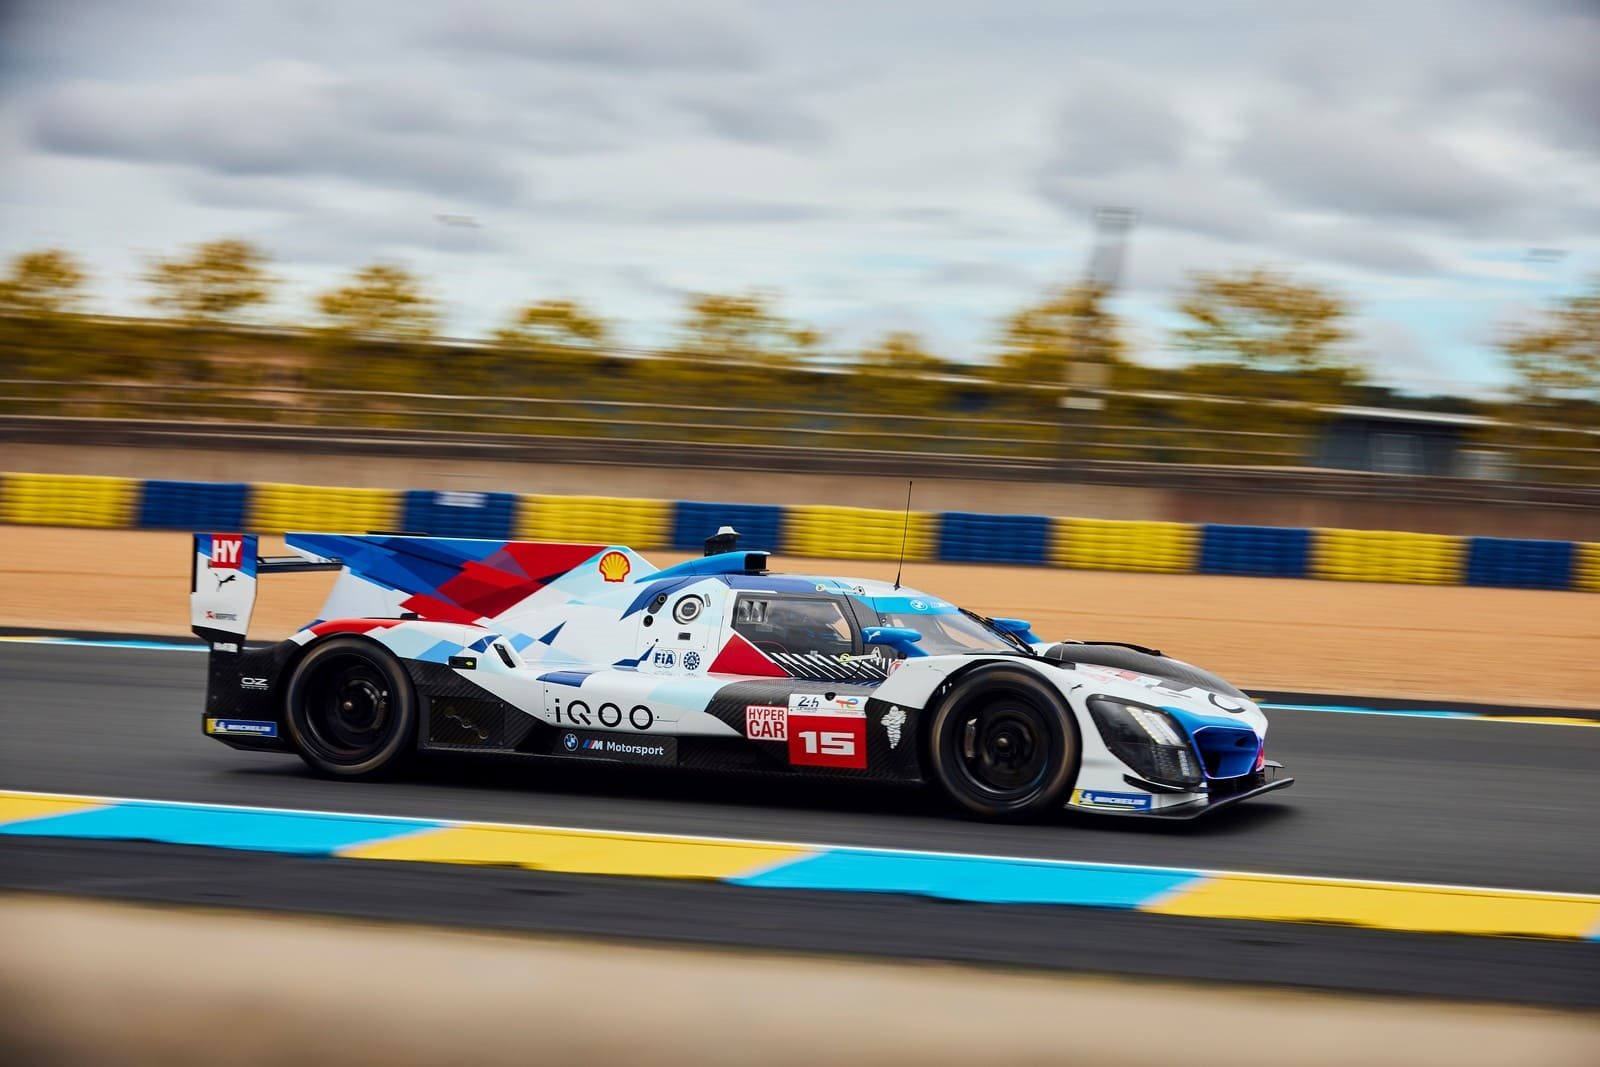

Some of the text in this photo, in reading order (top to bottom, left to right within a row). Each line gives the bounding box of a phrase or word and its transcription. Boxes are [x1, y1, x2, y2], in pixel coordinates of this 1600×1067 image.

[212, 539, 242, 563] HY
[555, 698, 653, 730] iQOO
[748, 709, 785, 721] HYPER
[750, 720, 785, 738] CAR
[606, 741, 664, 756] Motorsport
[798, 731, 855, 755] 15
